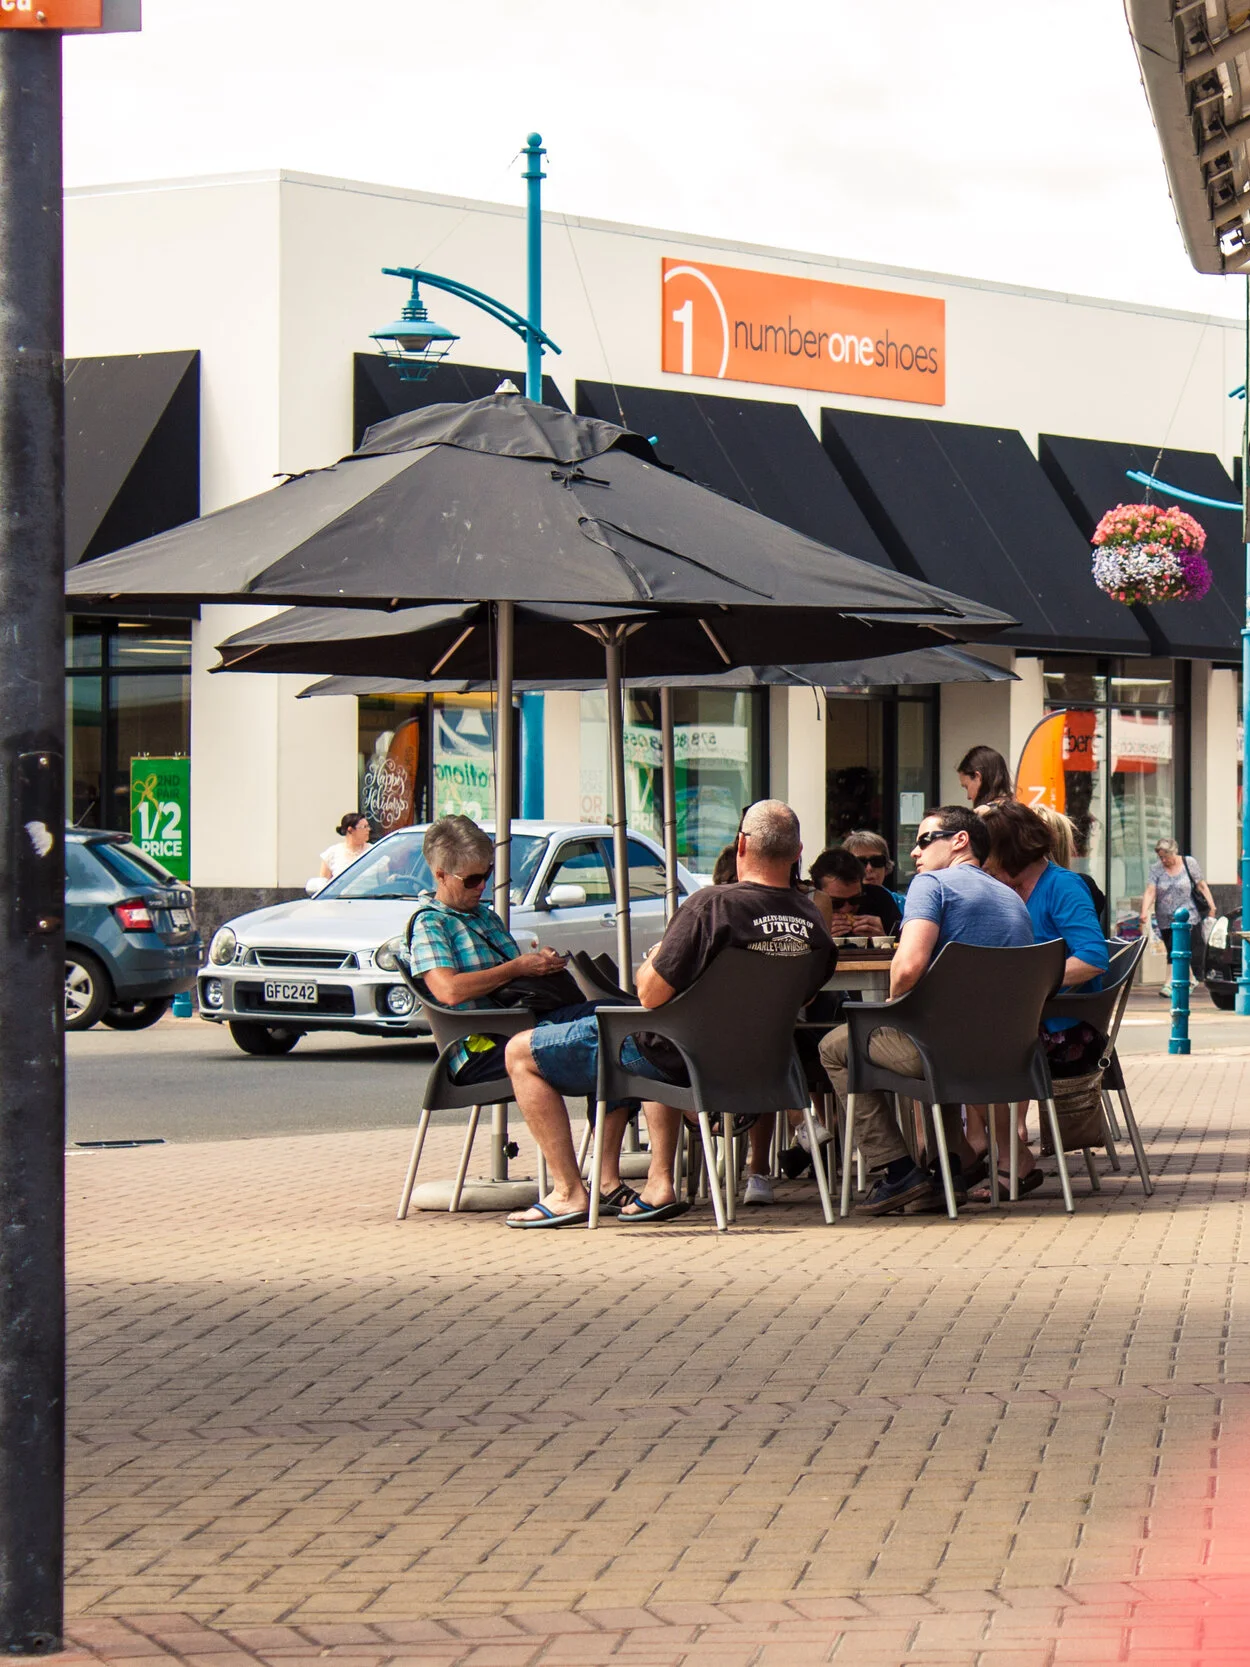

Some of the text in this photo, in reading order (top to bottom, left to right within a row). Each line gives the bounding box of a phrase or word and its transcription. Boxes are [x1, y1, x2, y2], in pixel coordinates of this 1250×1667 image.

[672, 300, 693, 374] 1
[157, 775, 181, 787] 2ND
[365, 756, 407, 795] Happy
[157, 788, 180, 799] PAIR
[362, 785, 408, 828] Holidays
[139, 801, 182, 840] 1/2
[141, 840, 182, 857] PRICE
[753, 914, 806, 927] HARLEY-DAVIDSON
[762, 921, 809, 939] UTICA
[266, 983, 315, 1001] GFC242
